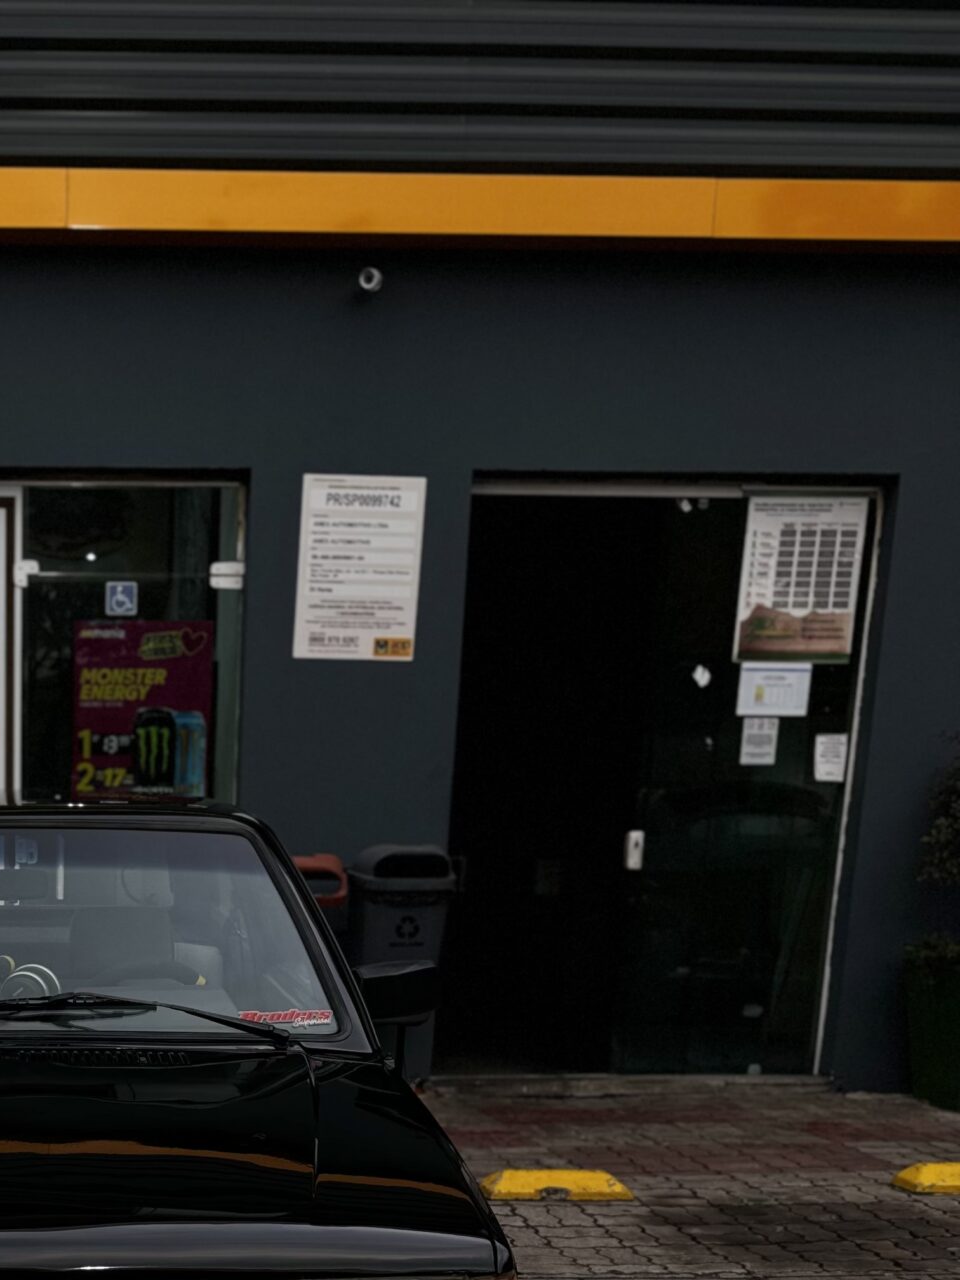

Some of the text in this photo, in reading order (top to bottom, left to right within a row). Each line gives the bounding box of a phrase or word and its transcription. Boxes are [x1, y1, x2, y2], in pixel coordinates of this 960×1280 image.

[80, 668, 168, 686] MONSTER
[80, 685, 150, 702] ENERGY
[76, 761, 96, 793] 2
